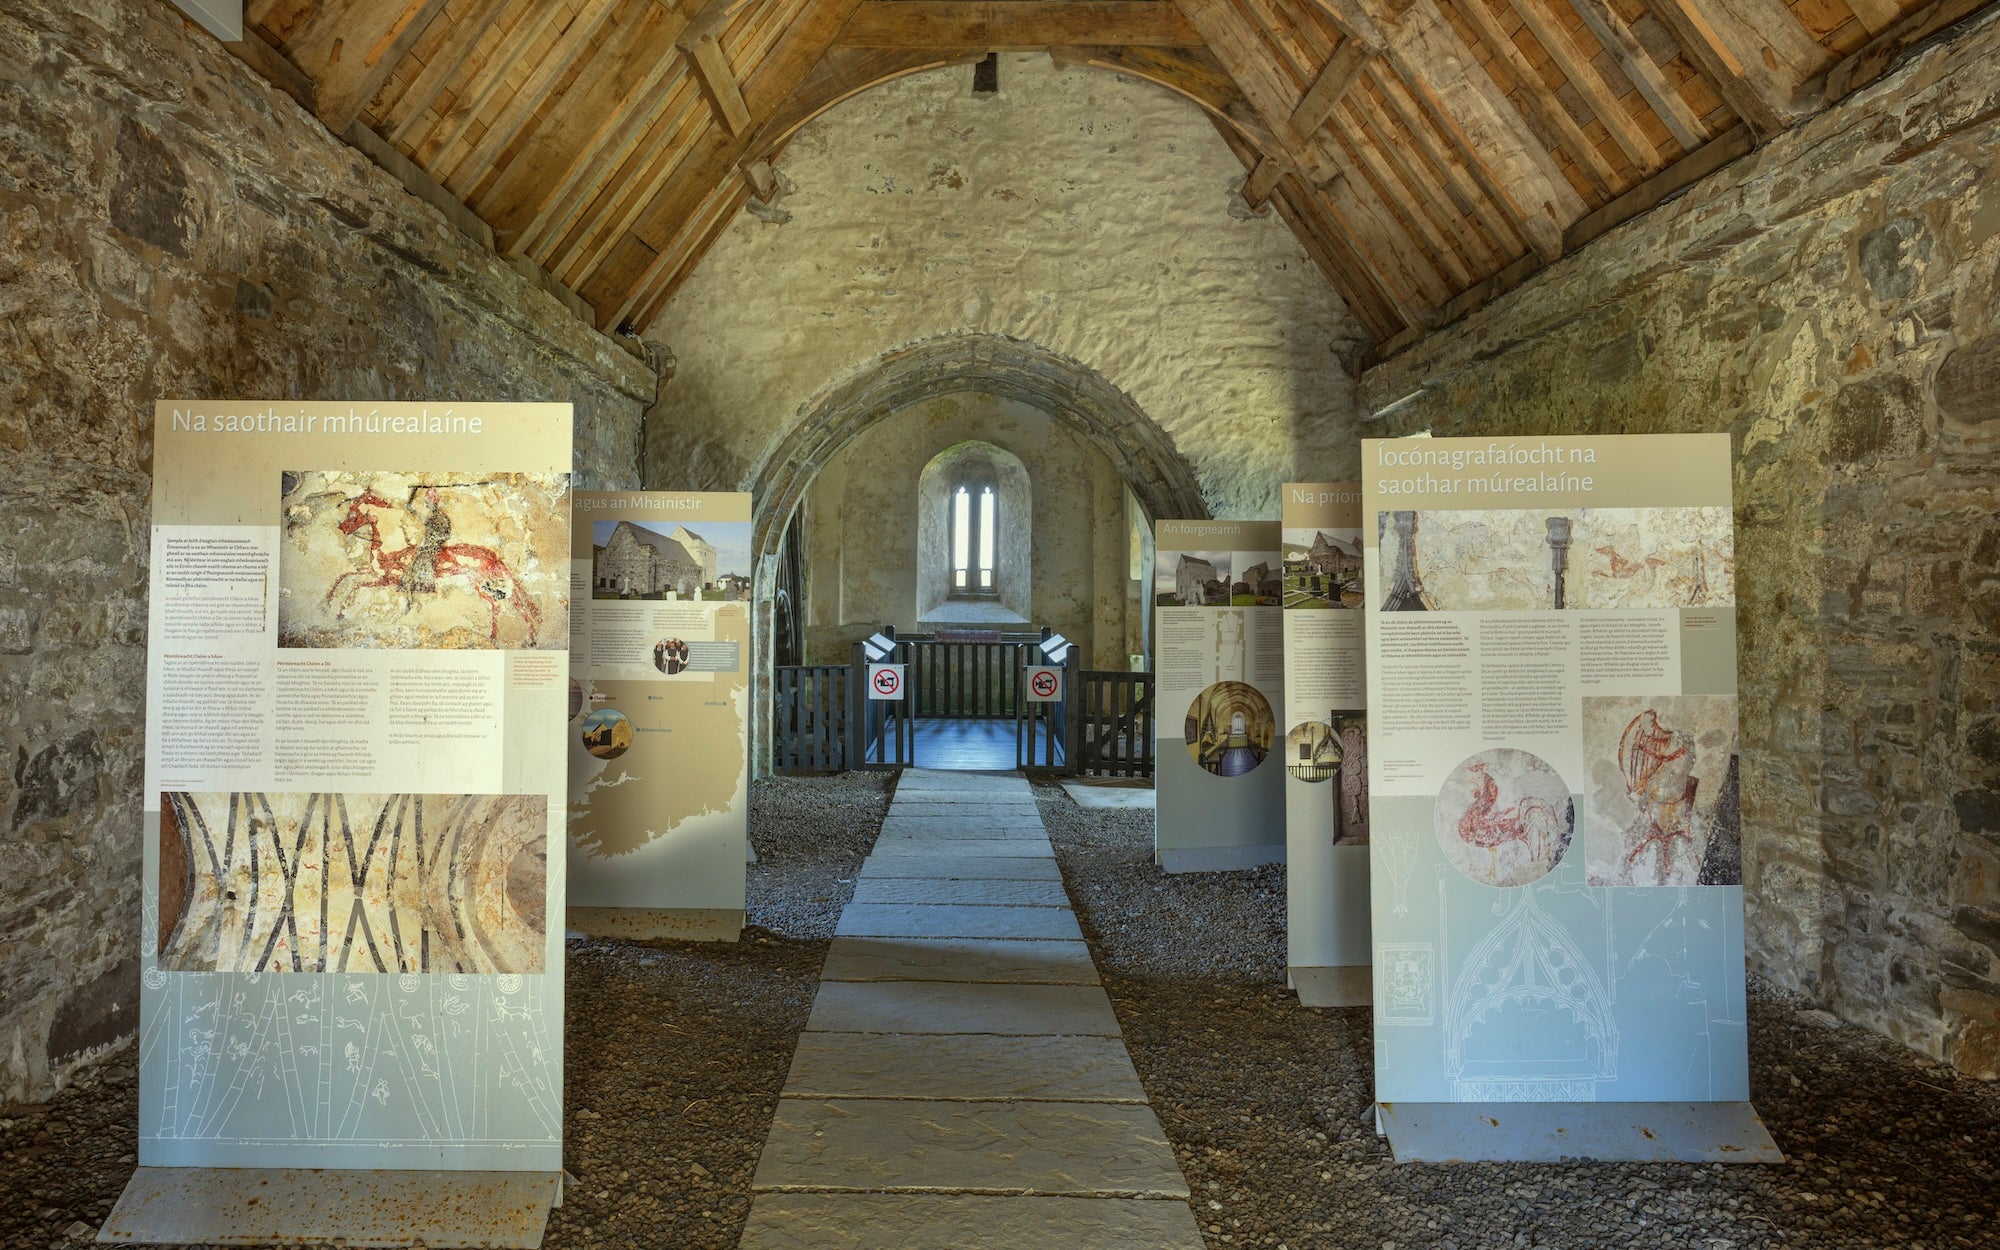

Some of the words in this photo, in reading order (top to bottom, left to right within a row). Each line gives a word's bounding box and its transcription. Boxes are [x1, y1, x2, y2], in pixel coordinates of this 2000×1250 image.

[172, 409, 207, 432] Na
[213, 409, 316, 432] saothair
[323, 409, 483, 434] mhúrealaíne
[1378, 441, 1564, 470] Íocónagrafaíocht
[1570, 448, 1596, 464] na
[1378, 473, 1462, 494] saothar
[1468, 471, 1593, 493] múrealaíne
[575, 499, 607, 512] agus
[610, 499, 627, 509] an
[630, 496, 701, 509] Mhainistir
[1293, 489, 1315, 503] Na
[1163, 523, 1178, 534] An
[1180, 522, 1241, 536] foirgneamh
